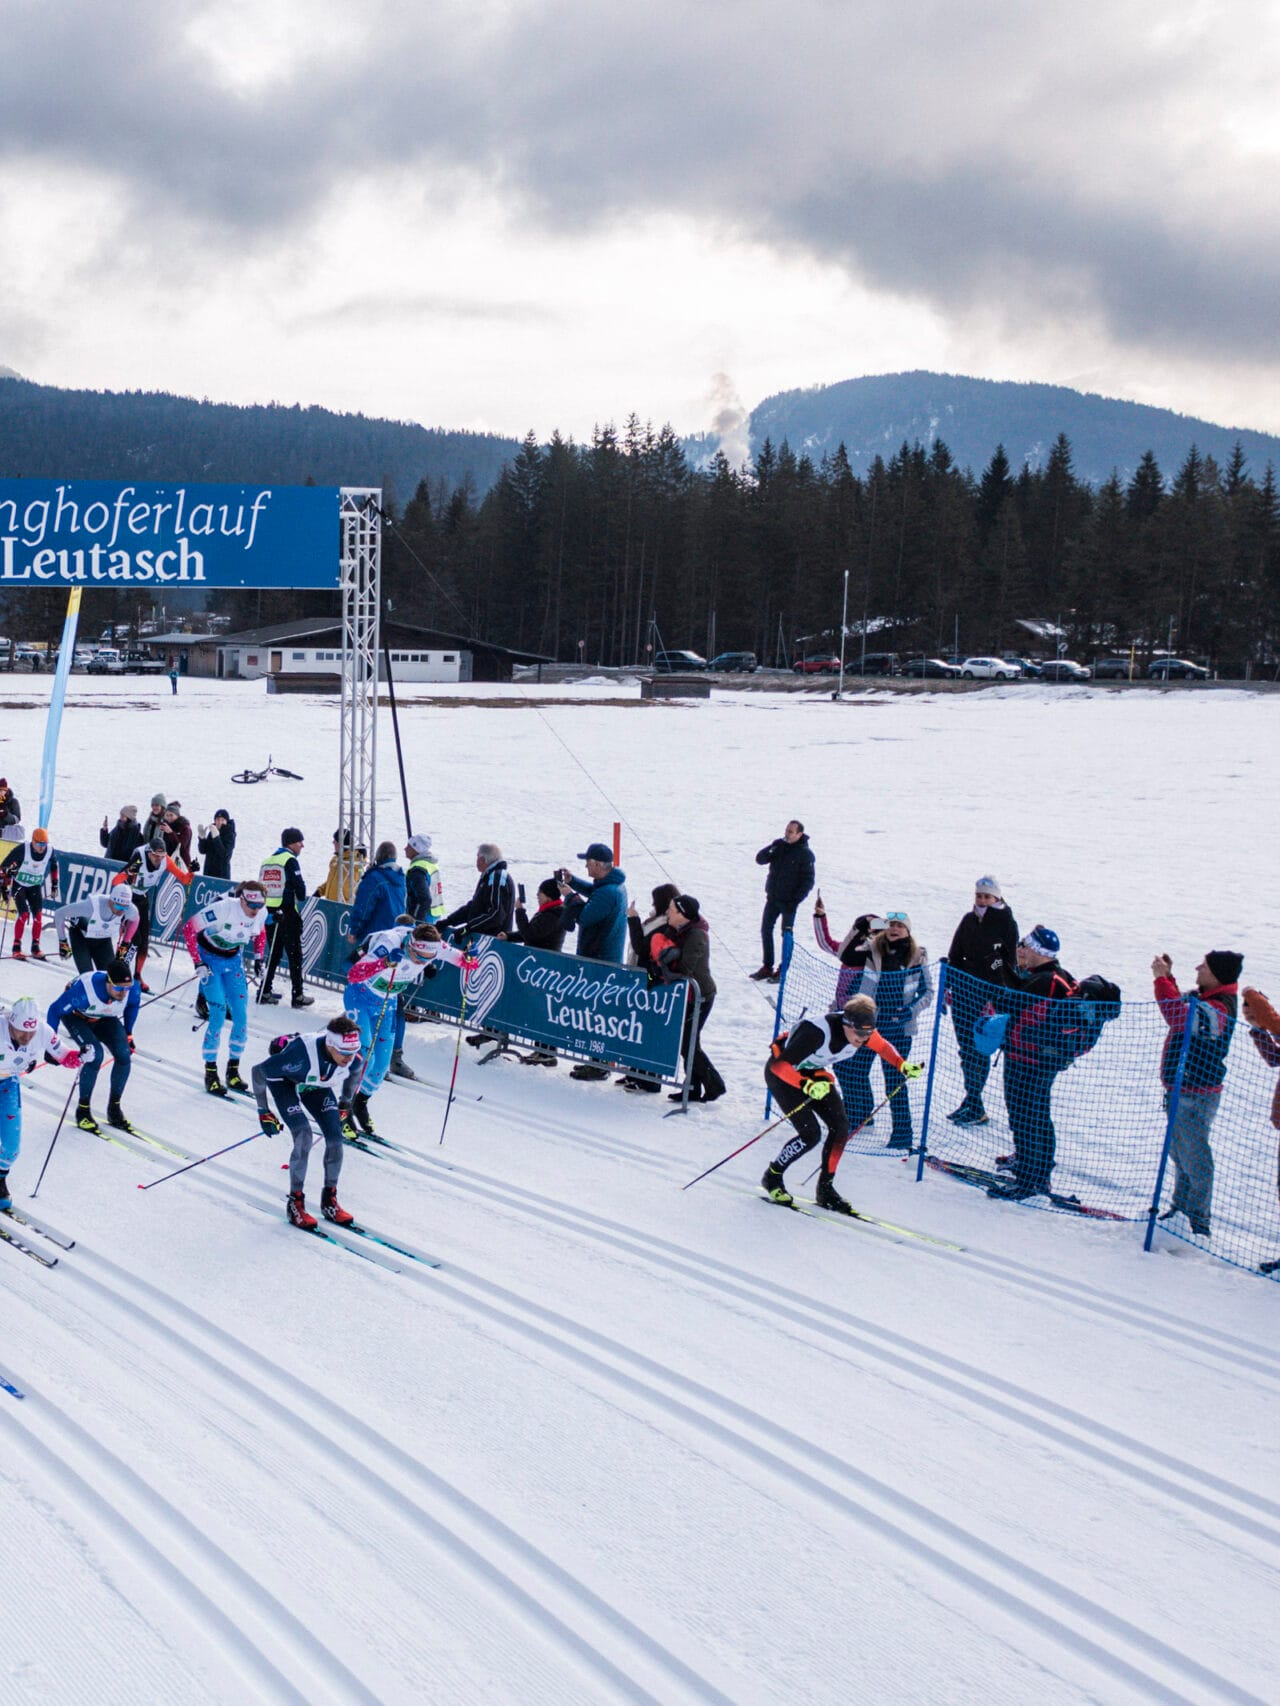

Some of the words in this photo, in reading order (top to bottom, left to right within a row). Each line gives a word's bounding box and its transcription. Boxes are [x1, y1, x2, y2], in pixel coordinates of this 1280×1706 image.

[0, 536, 207, 580] Leutasch
[516, 955, 684, 1026] Ganghoferlauf
[545, 993, 643, 1044] Leutasch
[574, 1038, 587, 1050] EST.
[589, 1040, 605, 1054] 1968
[776, 1138, 807, 1167] TERREX
